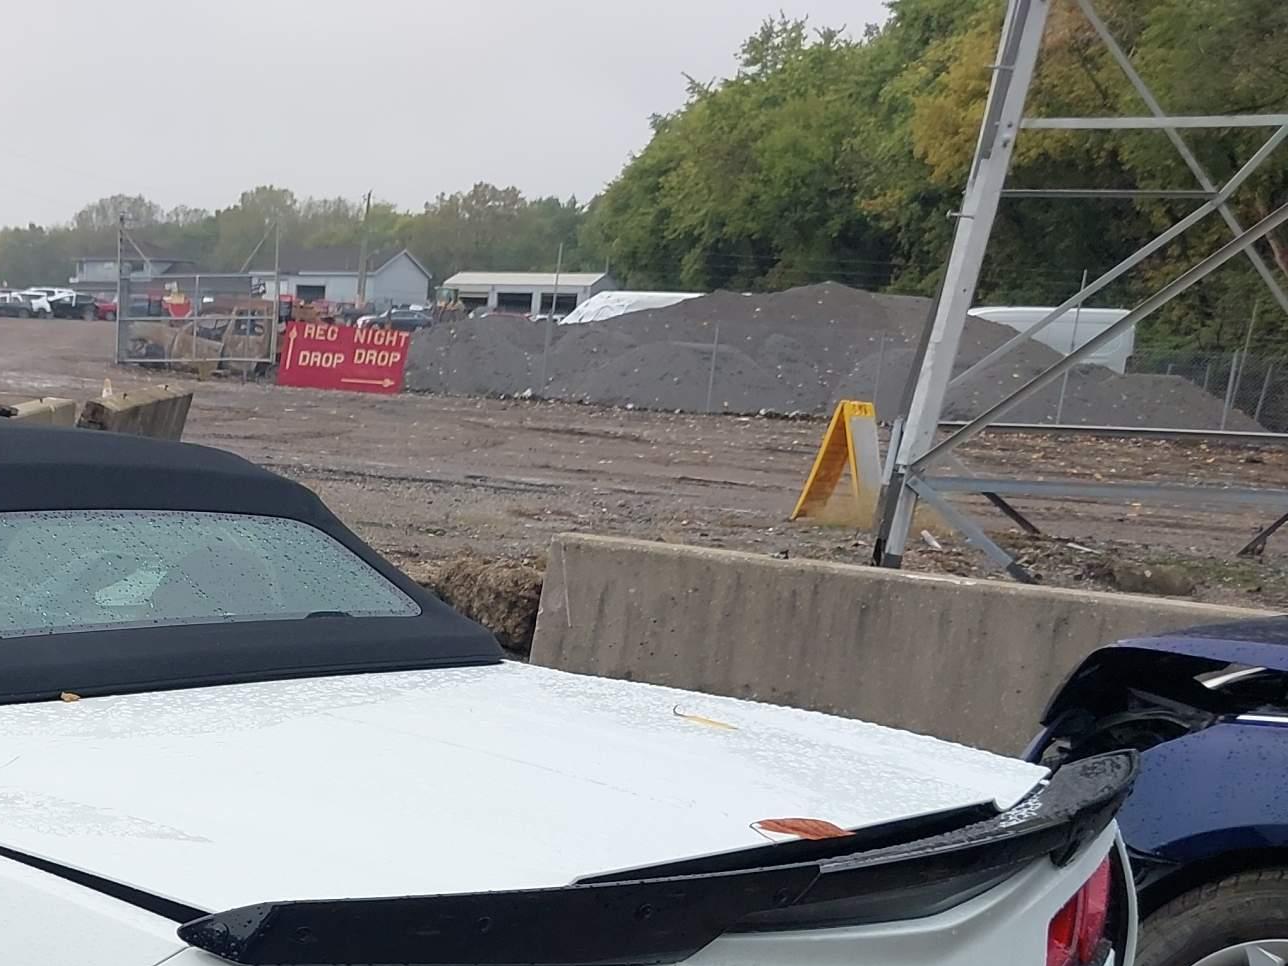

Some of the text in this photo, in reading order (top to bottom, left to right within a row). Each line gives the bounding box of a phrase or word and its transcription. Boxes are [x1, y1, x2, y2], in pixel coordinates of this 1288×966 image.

[354, 329, 409, 347] NIGHT
[298, 350, 344, 368] DROP
[354, 349, 401, 367] DROP
